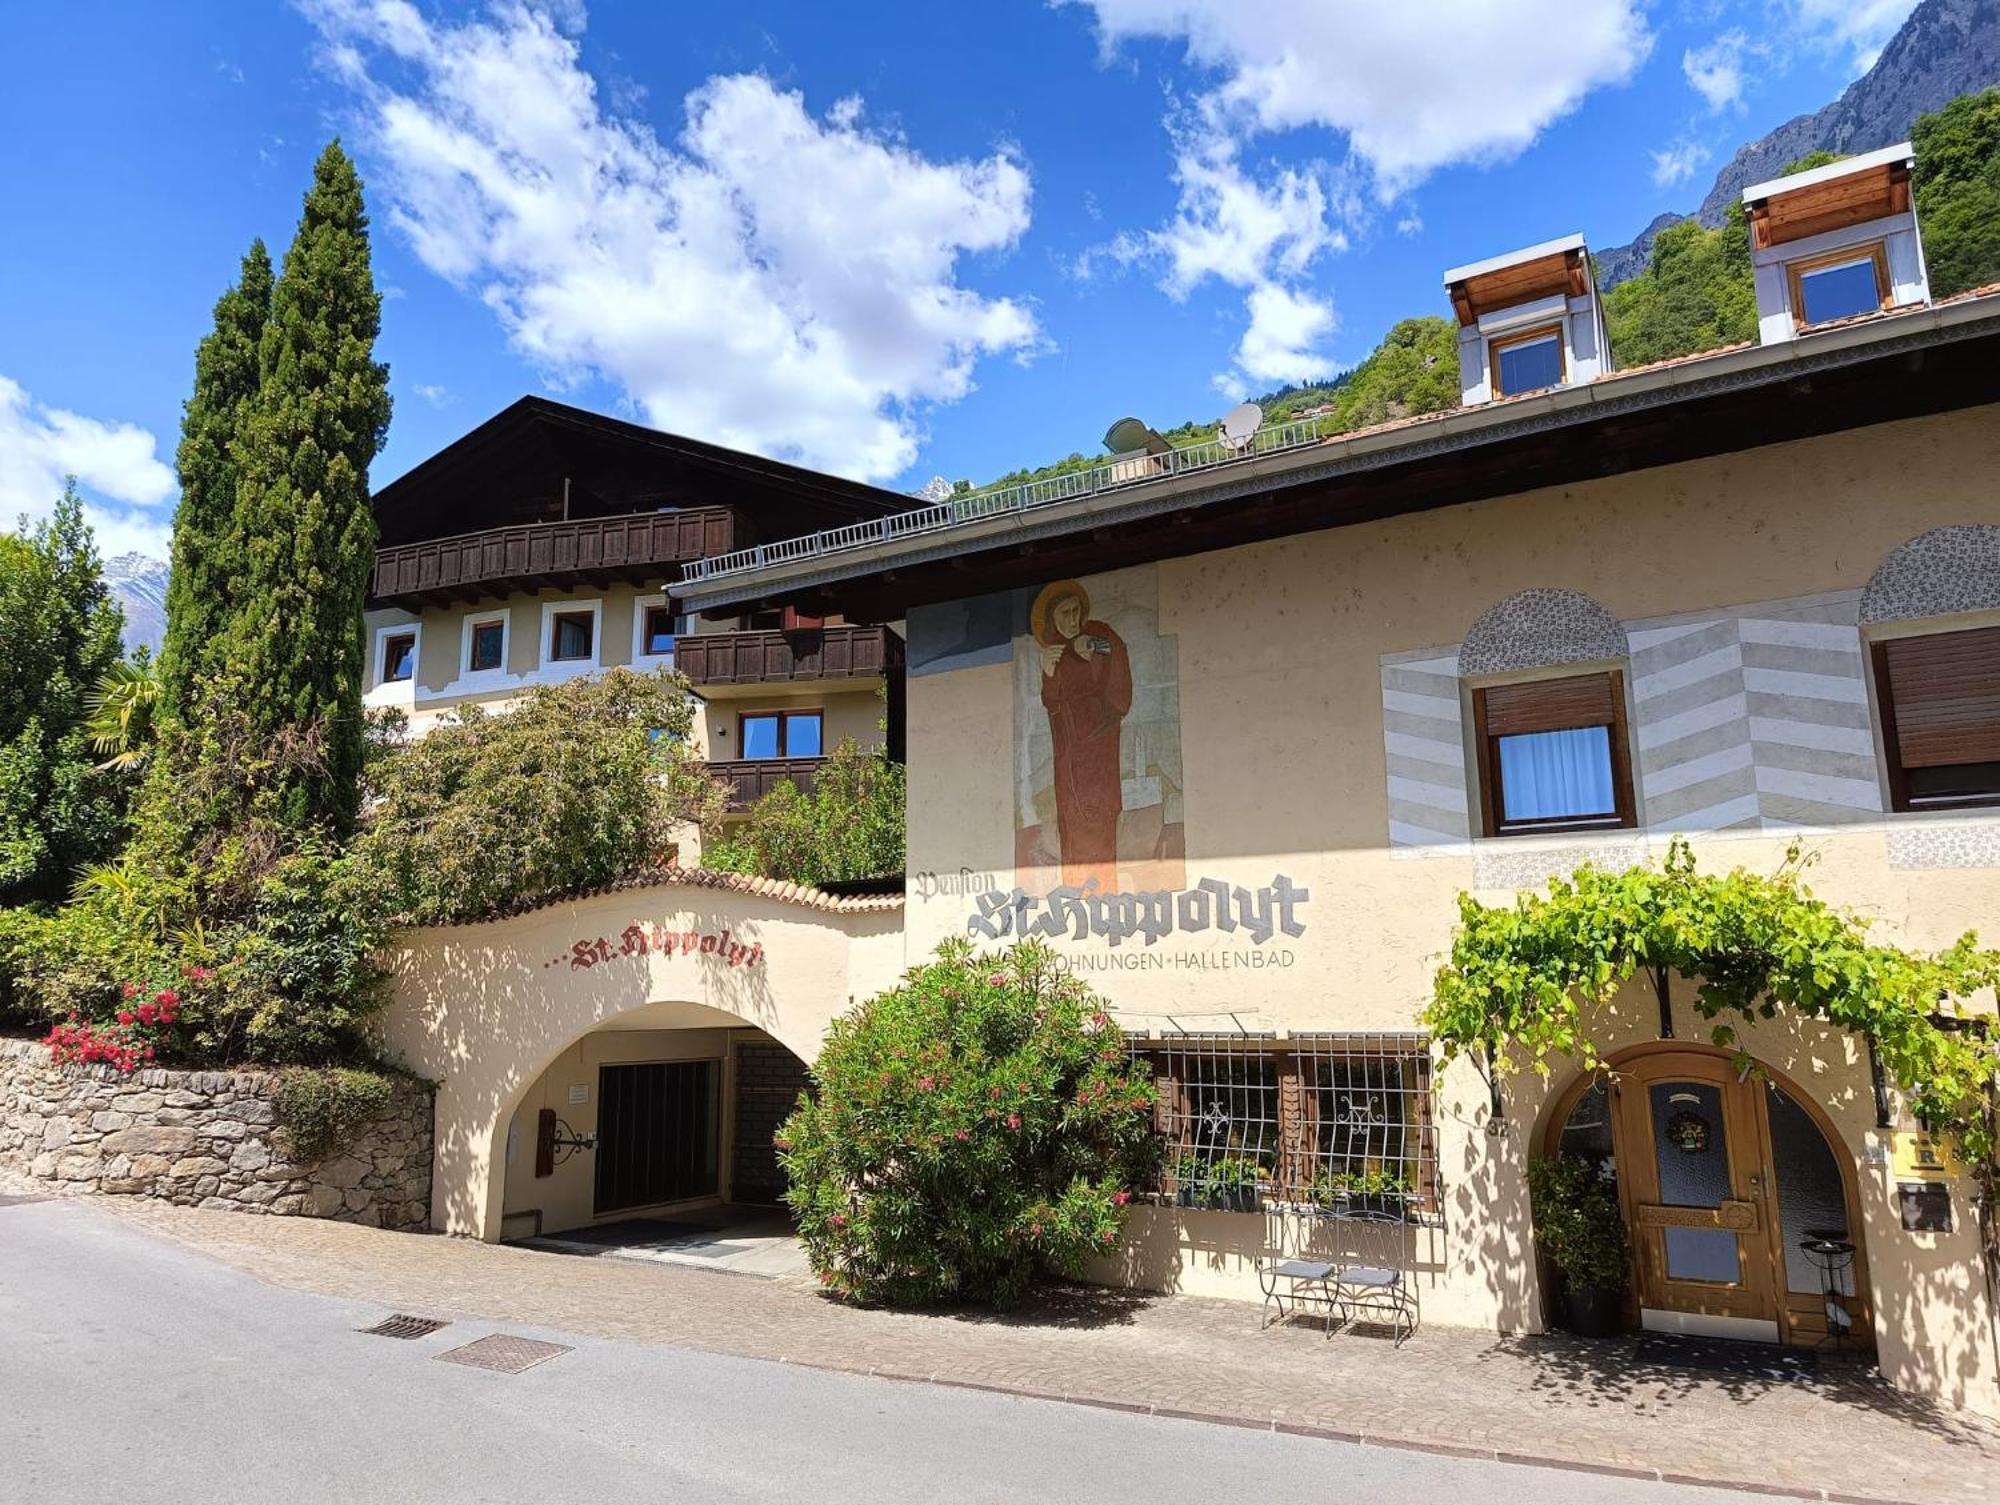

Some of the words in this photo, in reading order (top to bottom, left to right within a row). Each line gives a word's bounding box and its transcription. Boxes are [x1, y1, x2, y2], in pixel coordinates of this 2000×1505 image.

[1038, 873, 1309, 947] Hippolyt
[619, 925, 764, 967] Hippolyt
[1049, 952, 1164, 972] OHNUNGEN
[1175, 949, 1294, 969] HALLENBAD
